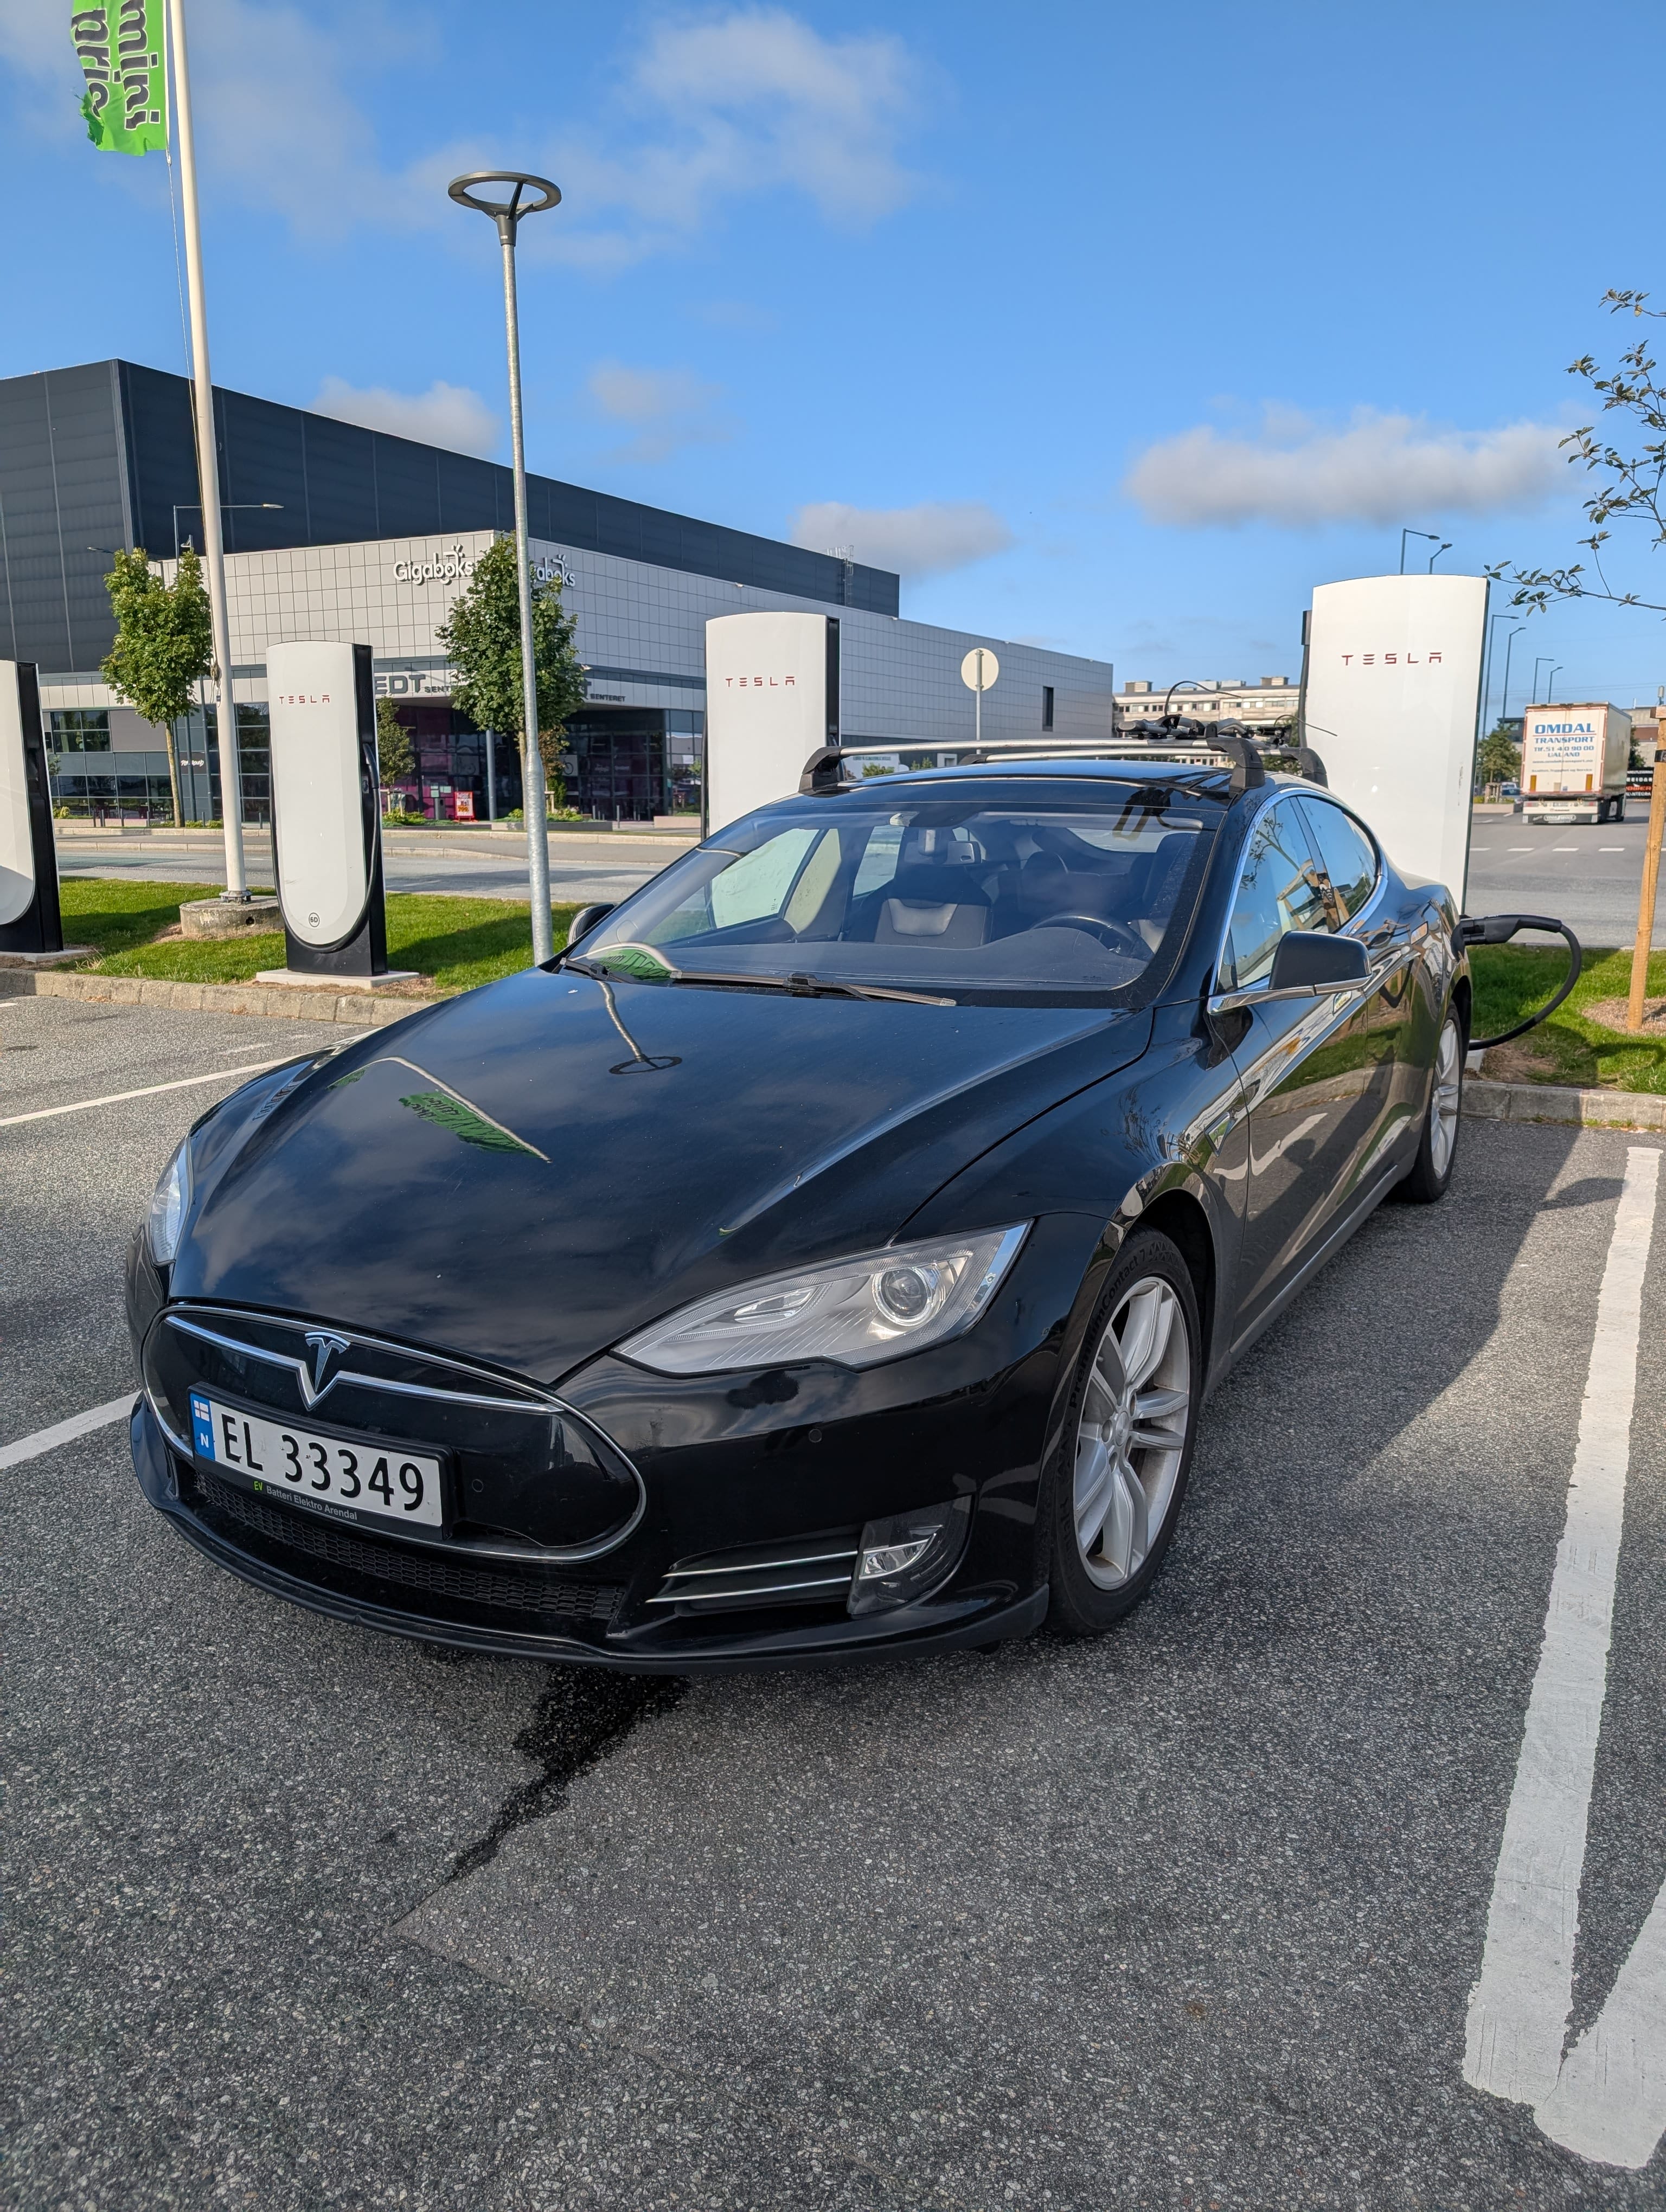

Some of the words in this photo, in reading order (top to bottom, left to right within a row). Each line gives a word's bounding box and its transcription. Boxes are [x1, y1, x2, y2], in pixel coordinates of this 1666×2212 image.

[393, 544, 474, 585] Gigaboks
[1341, 652, 1443, 666] TESLA
[725, 676, 795, 687] TESLA
[279, 695, 330, 704] TESLA
[1535, 723, 1595, 734] OMDAL
[200, 1432, 209, 1449] N
[221, 1413, 264, 1472] EL
[281, 1433, 425, 1512] 33349
[253, 1481, 263, 1491] EV
[266, 1486, 292, 1502] Batteri
[293, 1491, 323, 1511] Elektro
[324, 1501, 357, 1521] Arendal
